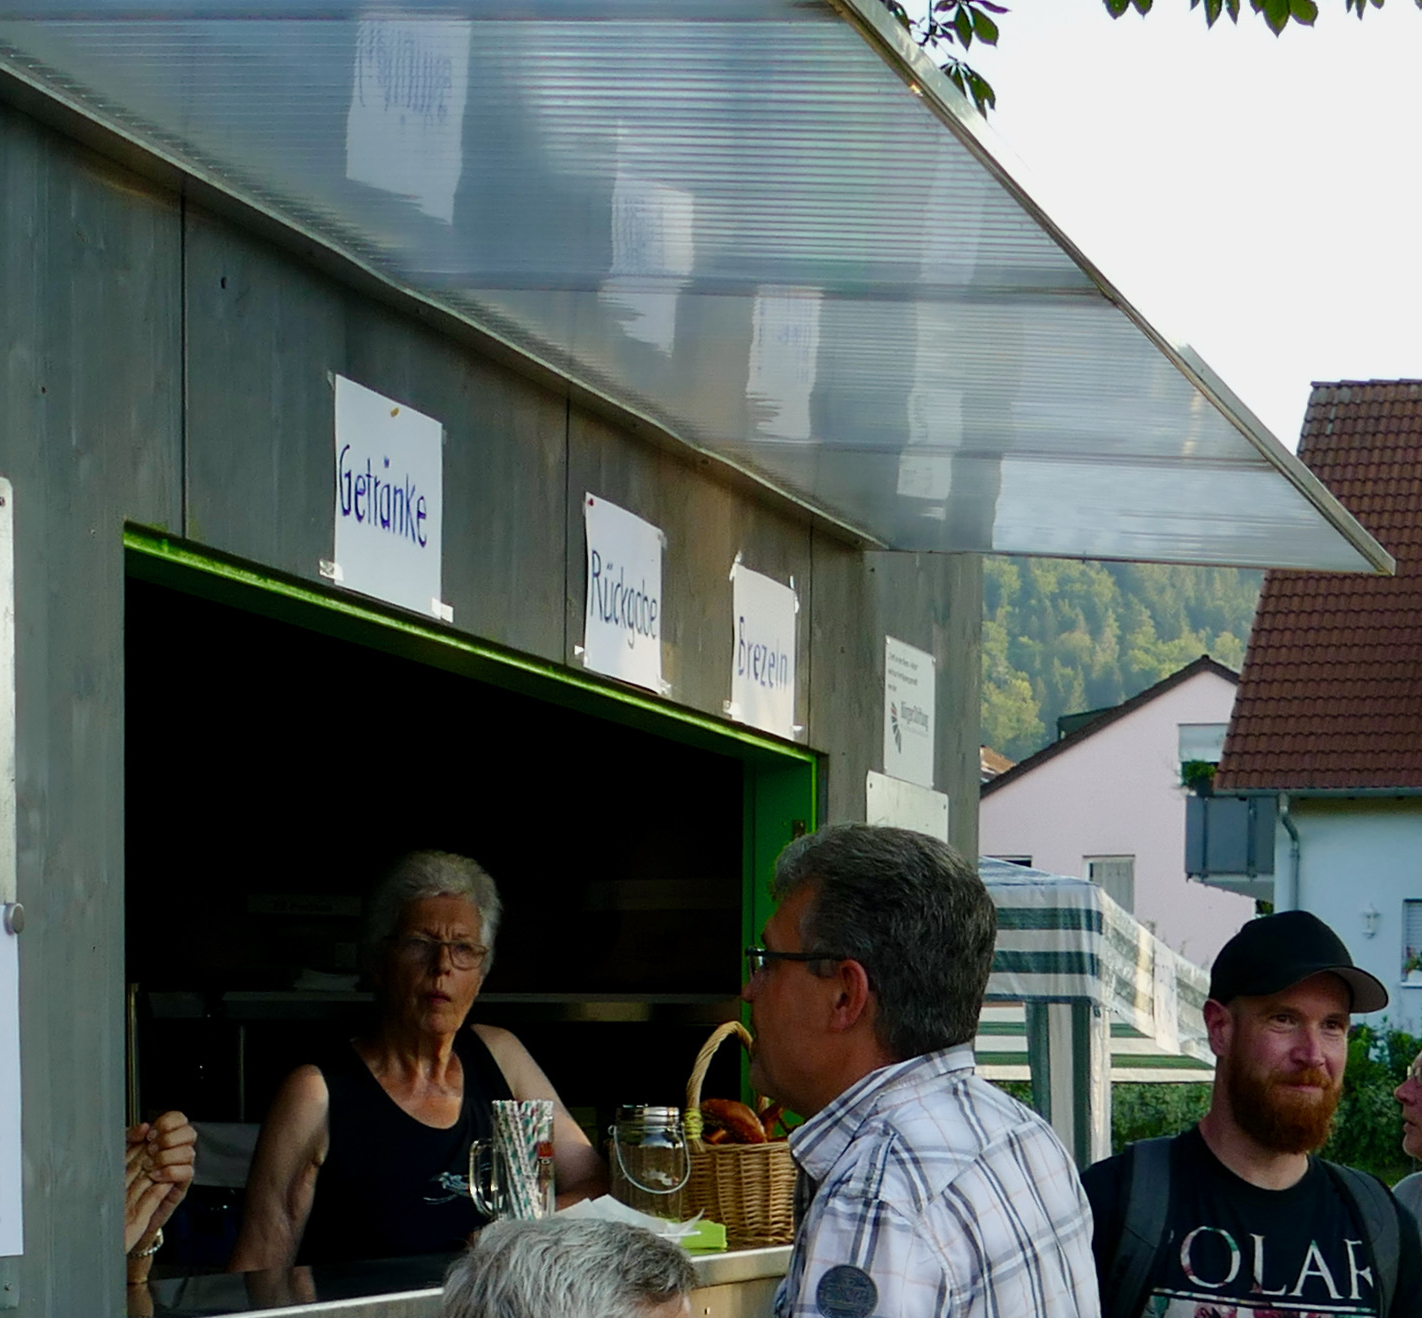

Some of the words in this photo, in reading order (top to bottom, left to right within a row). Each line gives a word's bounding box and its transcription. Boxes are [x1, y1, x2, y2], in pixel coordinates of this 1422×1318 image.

[339, 444, 427, 548] Getränke
[590, 549, 658, 649] Rückgabe
[739, 616, 788, 692] Brezeln
